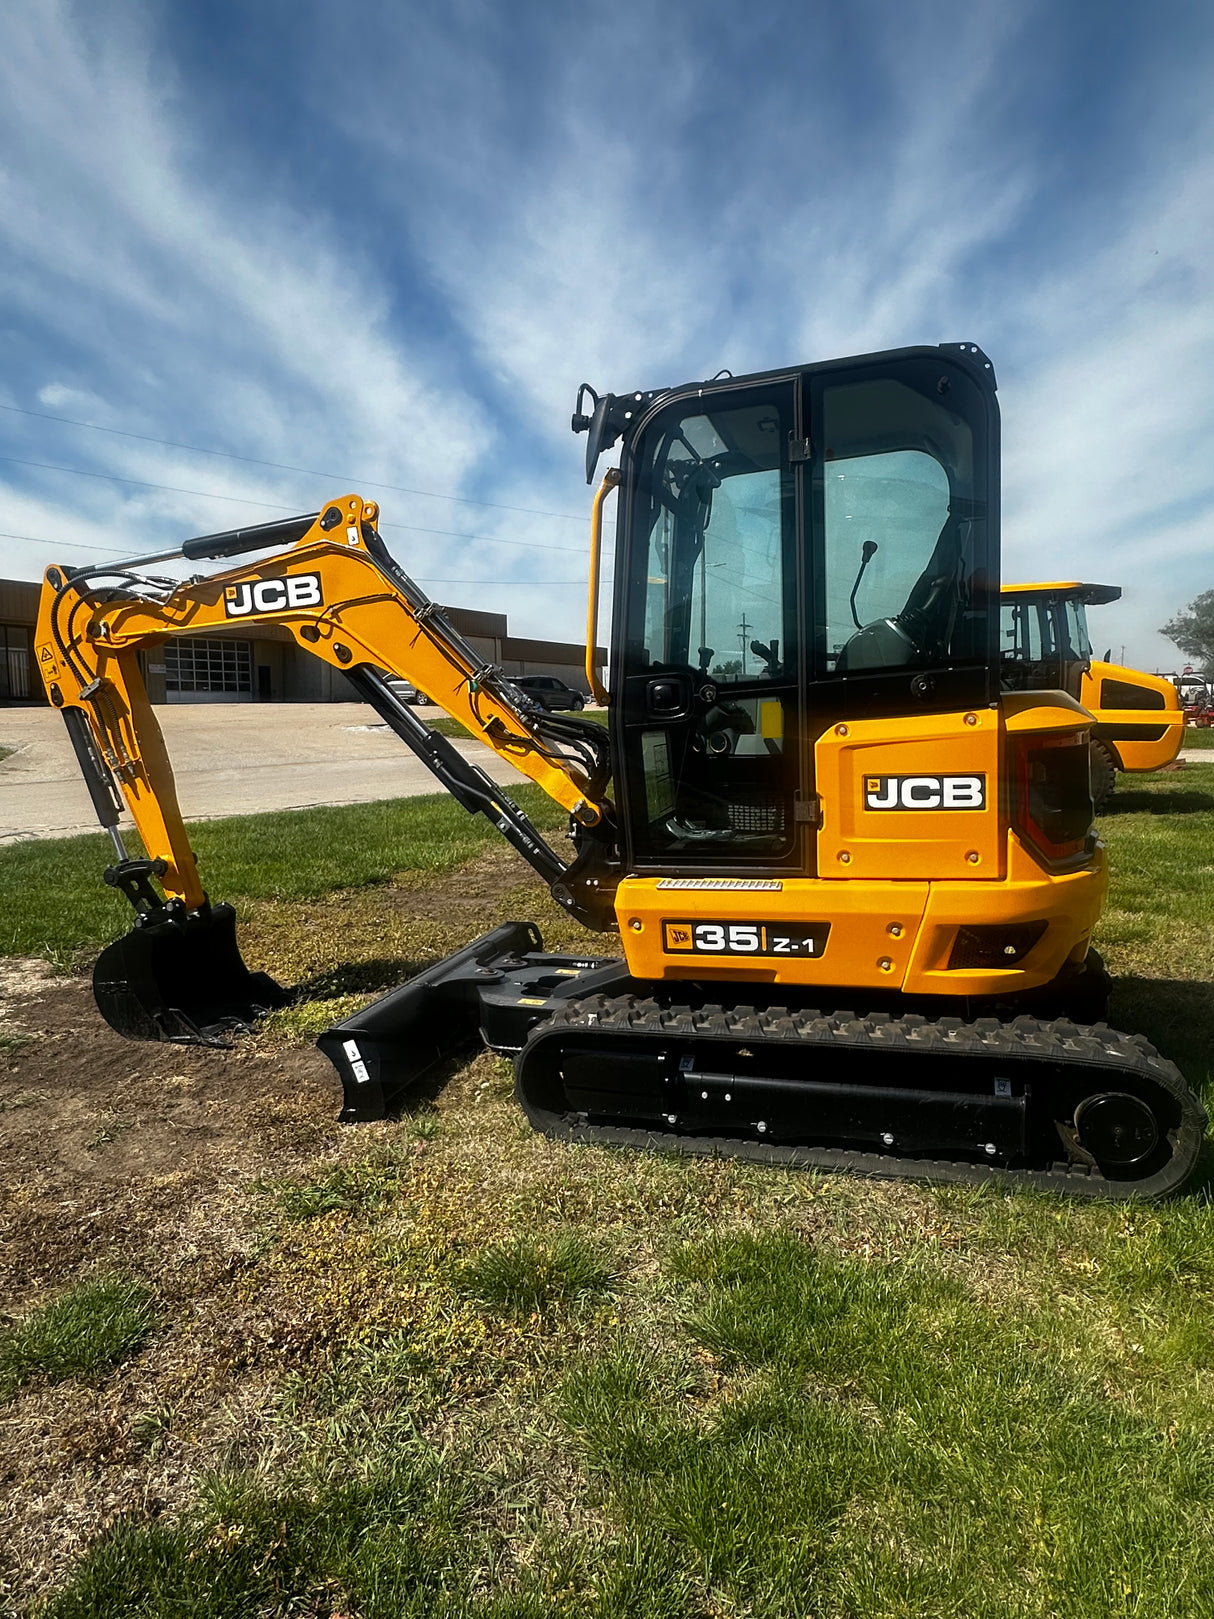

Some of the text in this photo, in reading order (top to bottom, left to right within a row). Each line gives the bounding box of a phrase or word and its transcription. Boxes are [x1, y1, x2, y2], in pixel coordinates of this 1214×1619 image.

[227, 575, 321, 615] JCB
[867, 777, 983, 808] JCB
[695, 925, 759, 951] 35
